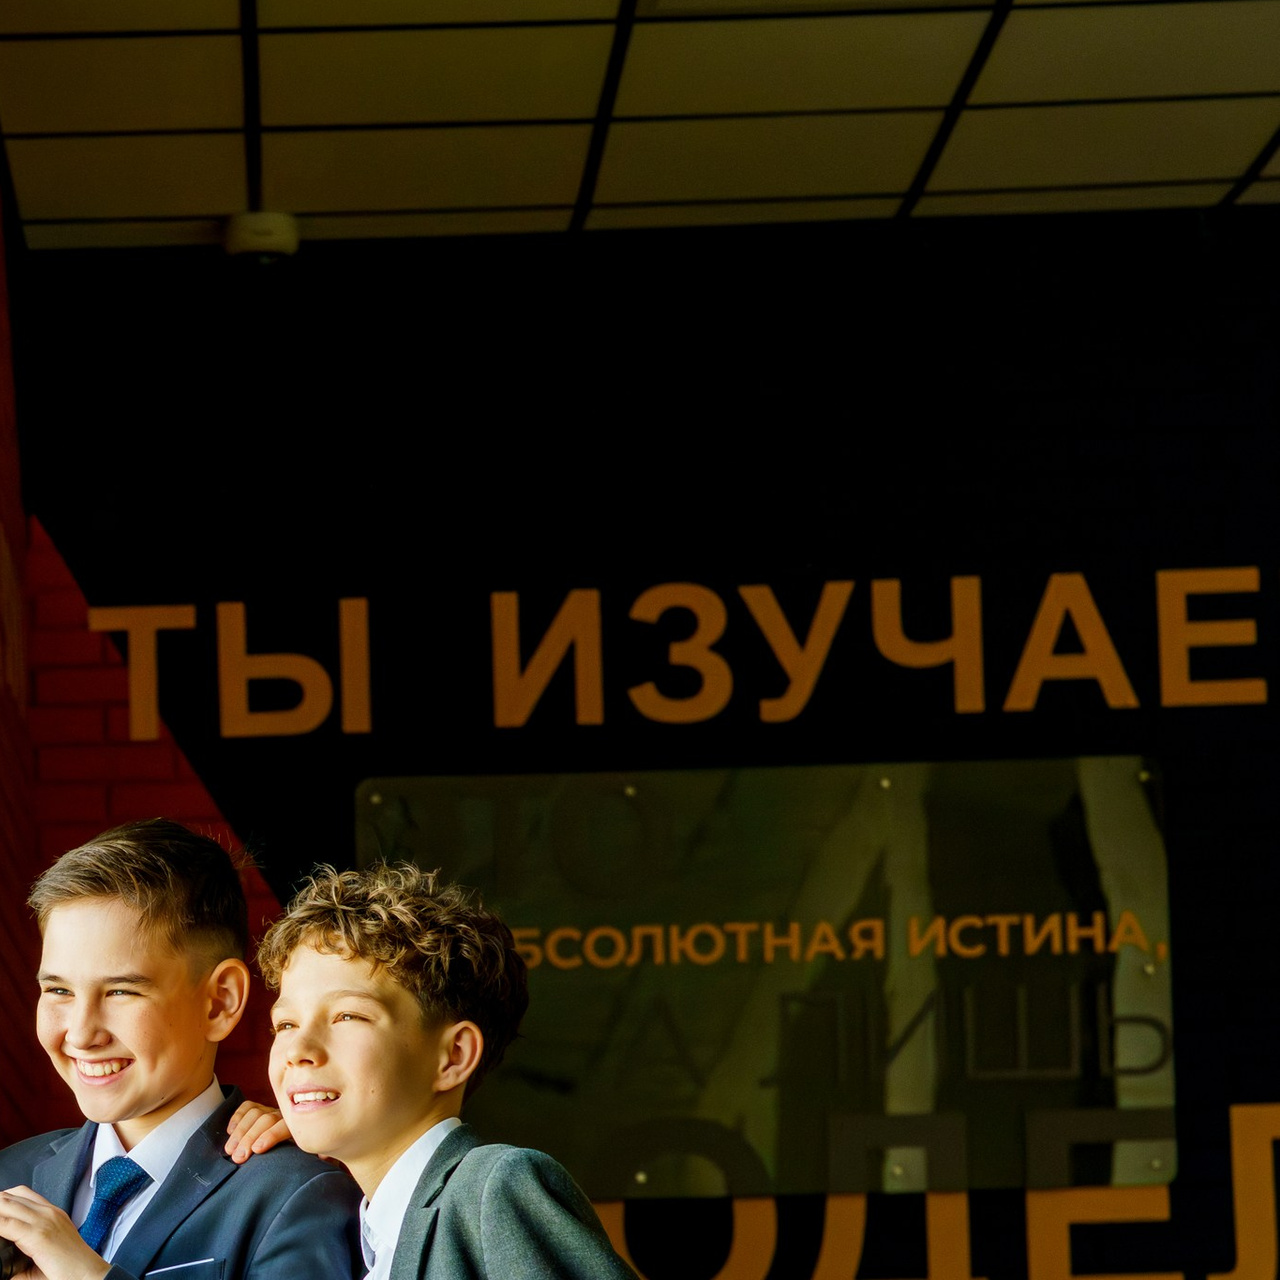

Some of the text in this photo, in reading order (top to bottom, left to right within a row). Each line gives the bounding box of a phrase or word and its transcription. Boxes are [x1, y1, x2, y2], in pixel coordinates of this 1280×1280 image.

[88, 567, 1280, 741] ТЫ ИЗУЧАЕ
[510, 909, 1168, 971] БСОЛЮТНАЯ ИСТИНА,
